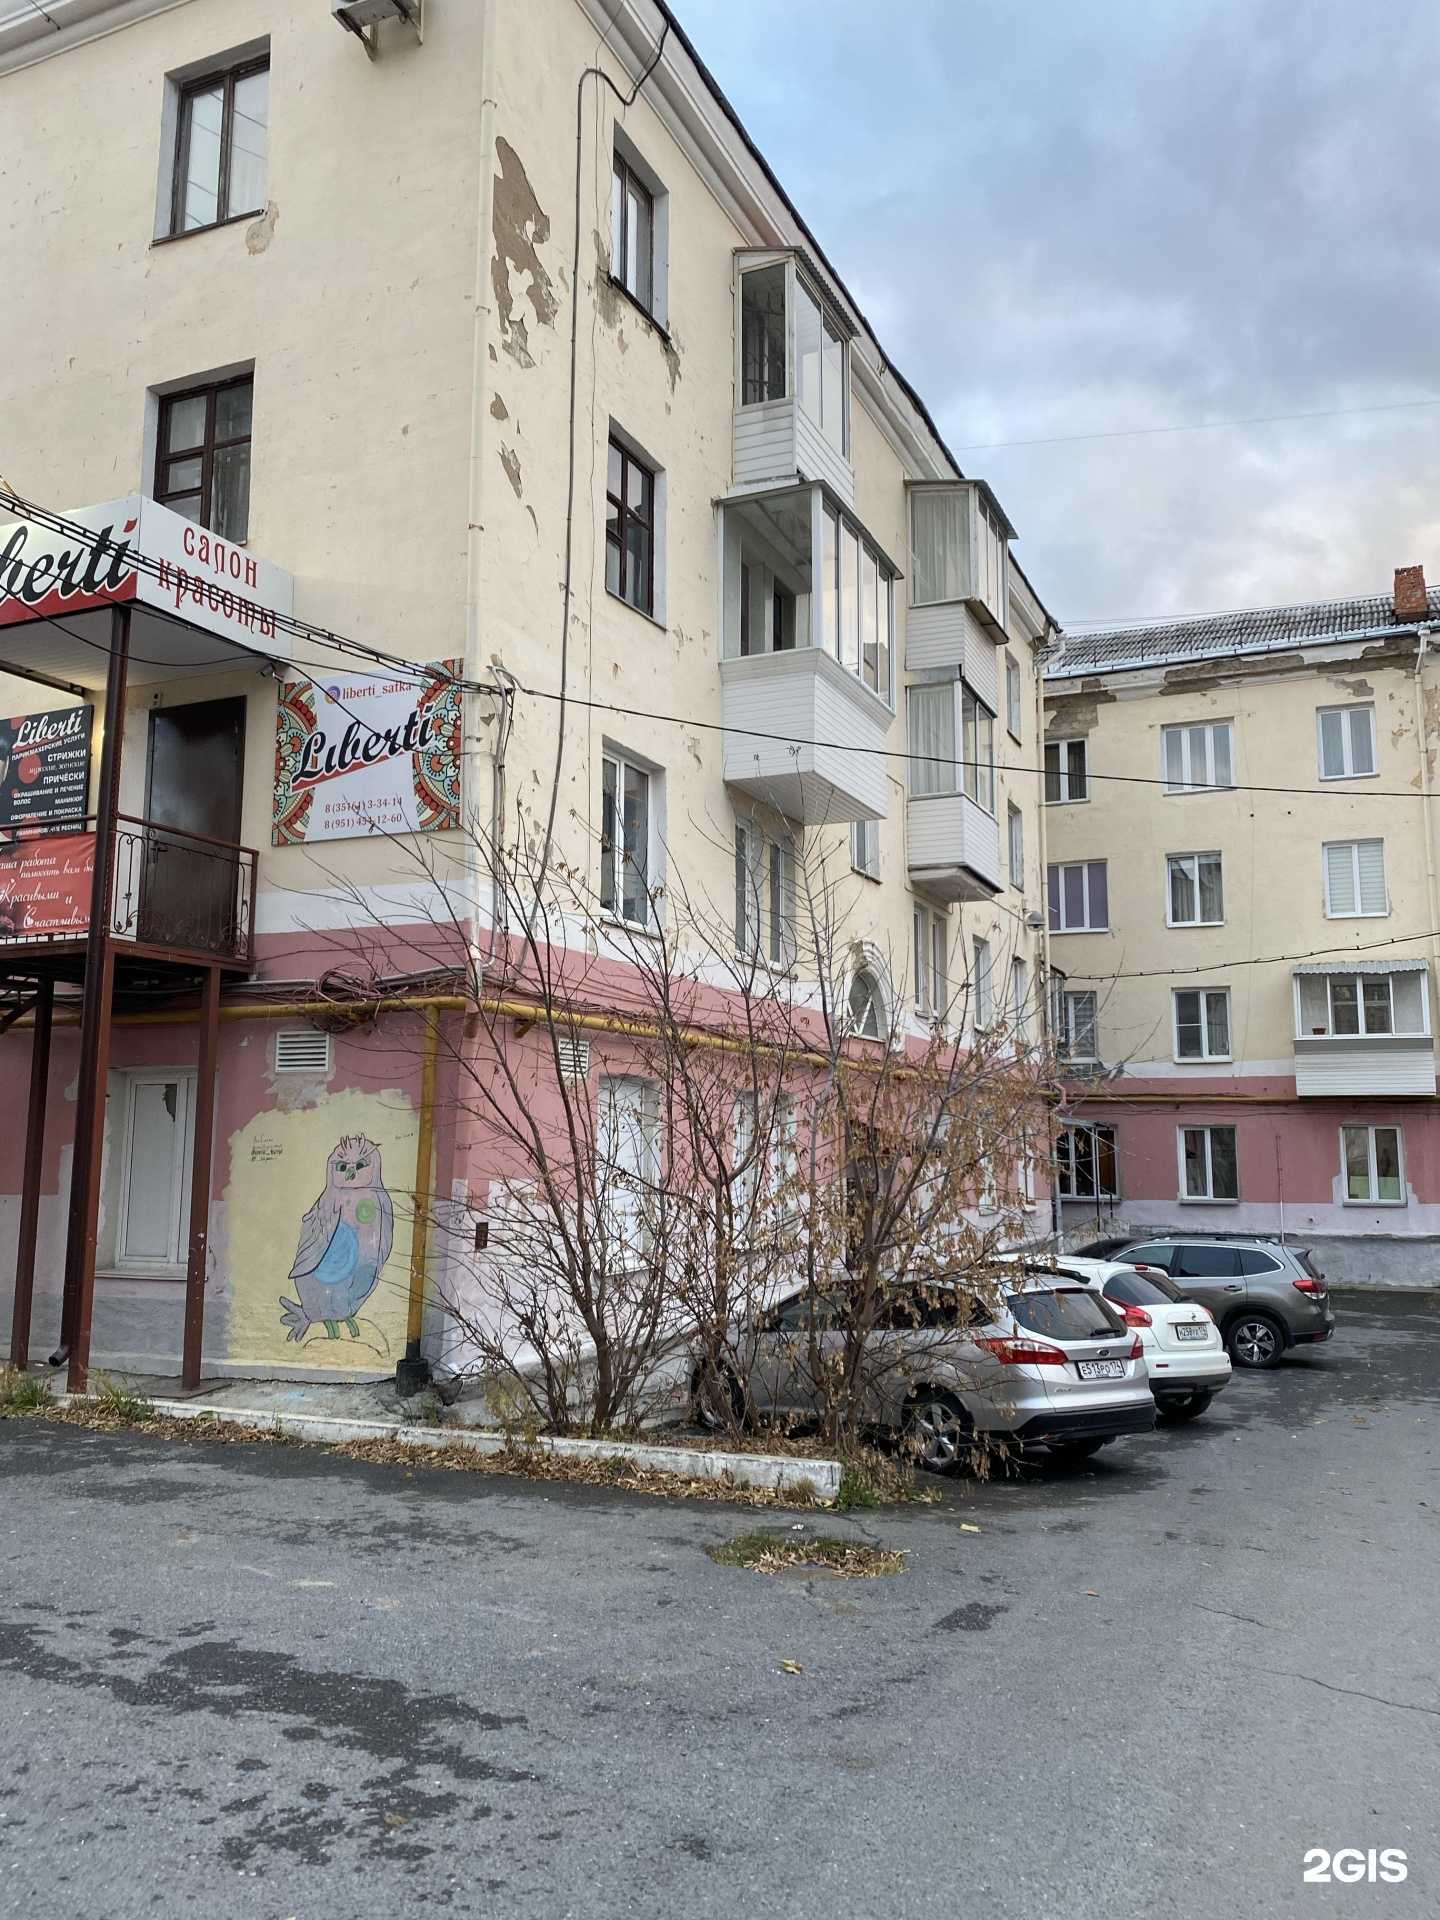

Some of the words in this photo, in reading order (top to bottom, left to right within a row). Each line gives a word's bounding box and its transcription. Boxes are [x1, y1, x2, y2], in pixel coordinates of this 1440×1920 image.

[183, 527, 259, 589] салон
[158, 557, 280, 639] красоты
[11, 710, 83, 749] Liberti
[291, 703, 435, 784] Liberti
[47, 749, 86, 762] СТРИЖКИ
[13, 798, 31, 806] ВОЛОС
[65, 895, 73, 905] и
